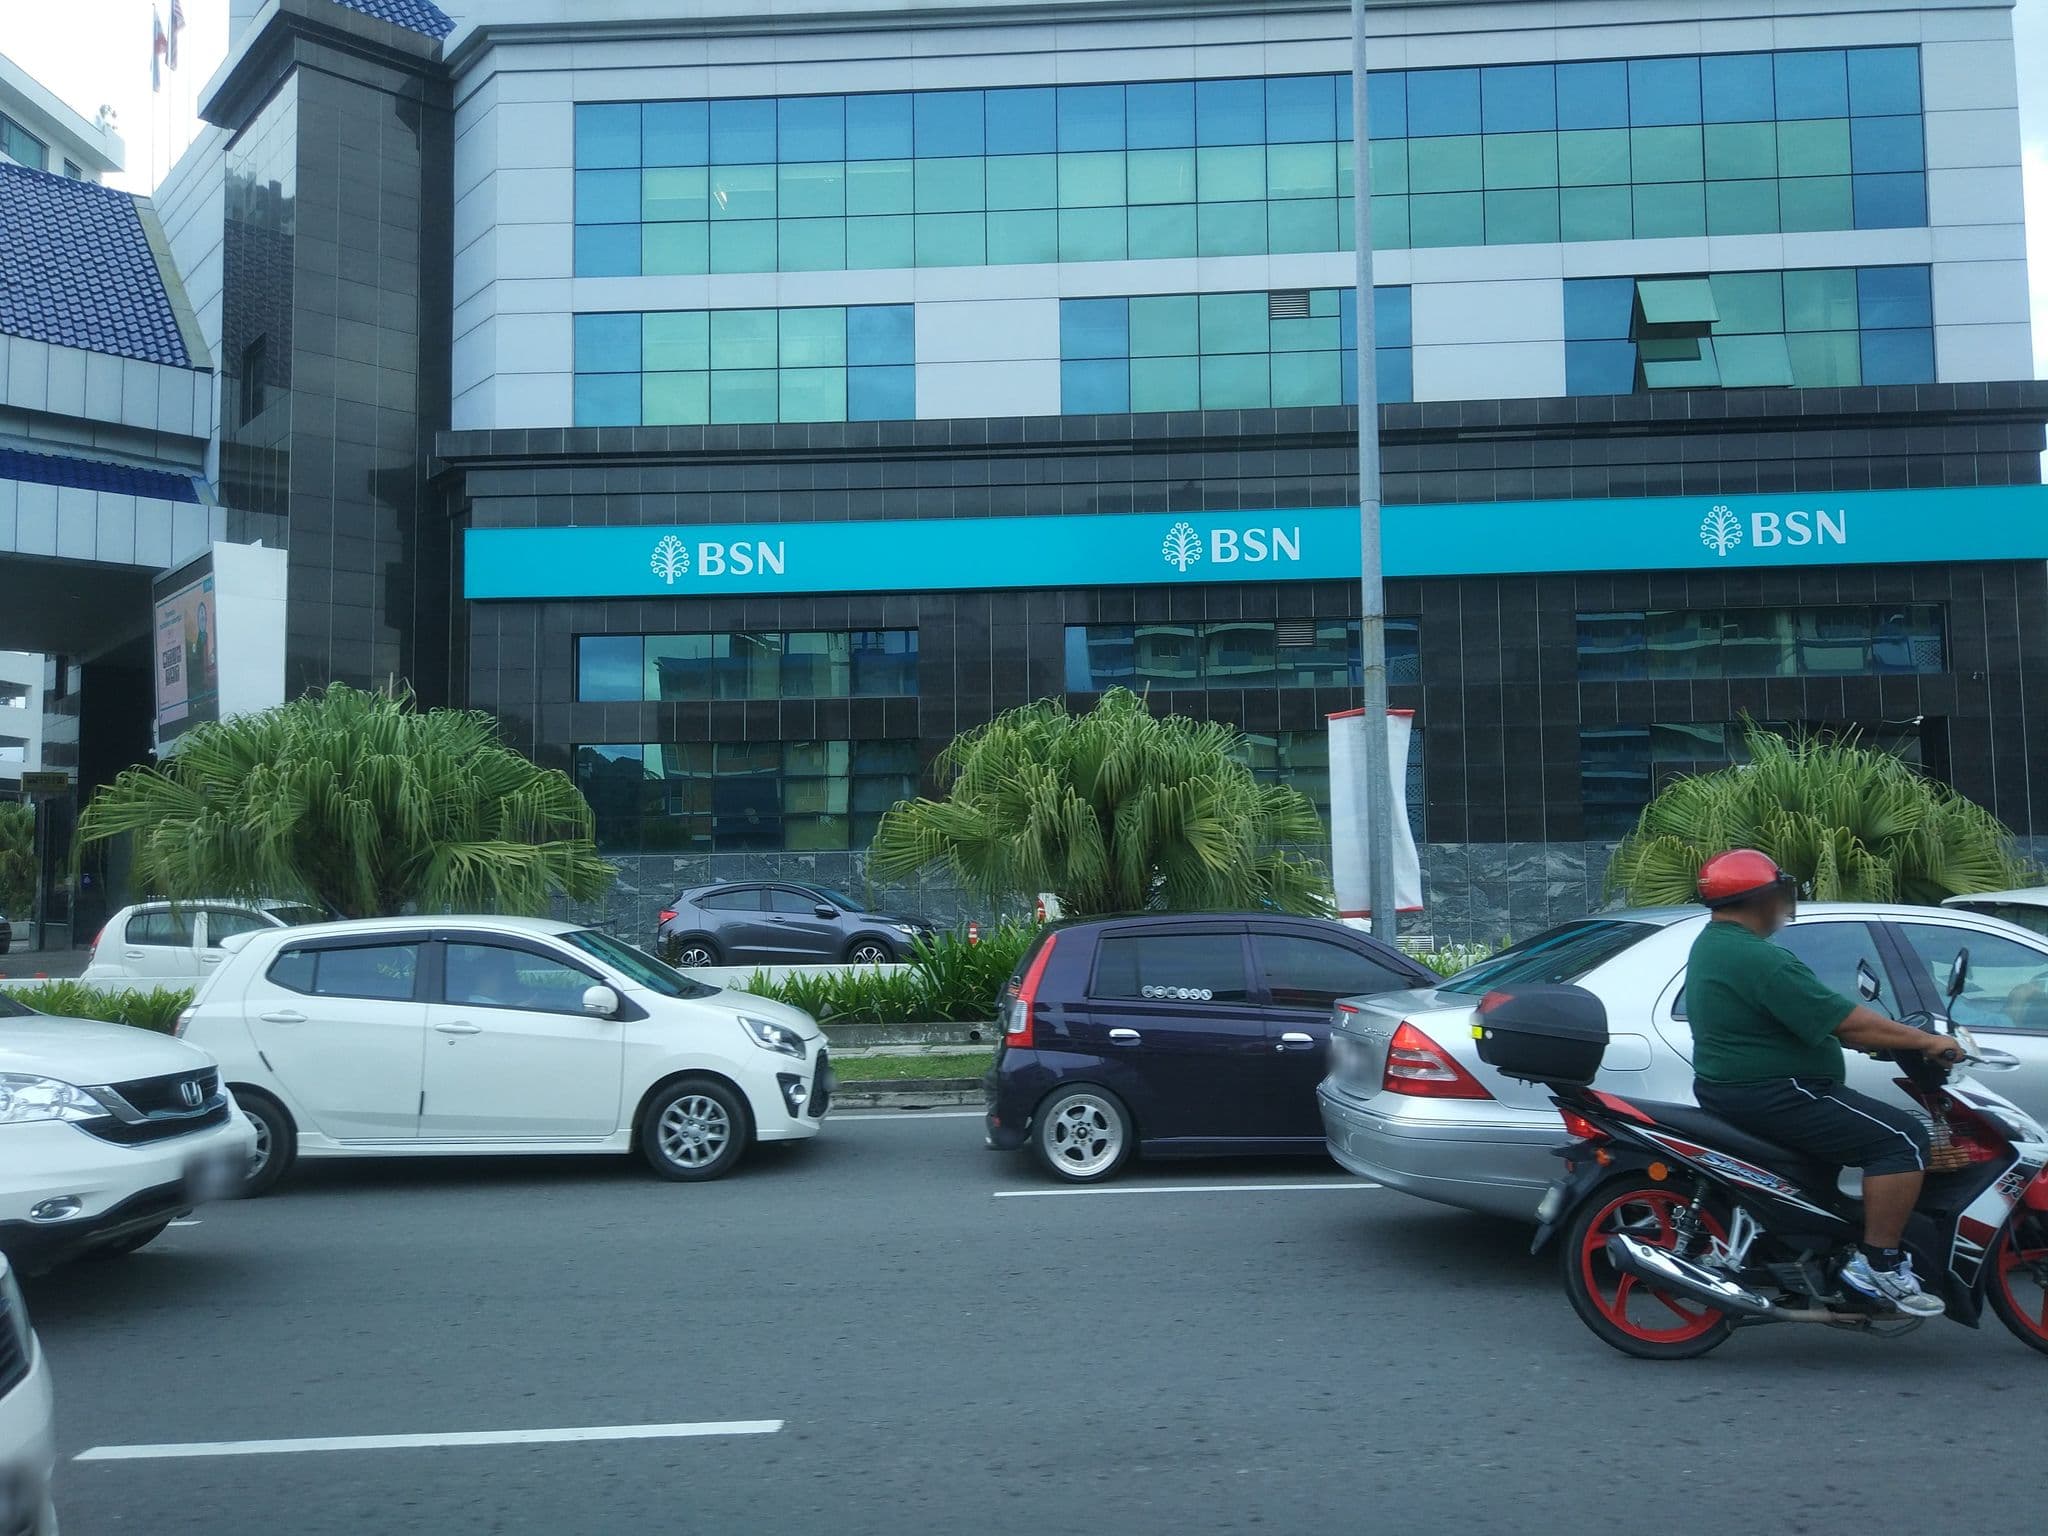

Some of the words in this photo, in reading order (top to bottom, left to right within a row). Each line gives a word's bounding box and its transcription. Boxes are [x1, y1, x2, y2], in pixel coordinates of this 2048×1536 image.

[1211, 526, 1300, 563] BSN
[1751, 509, 1847, 547] BSN
[698, 541, 785, 576] BSN
